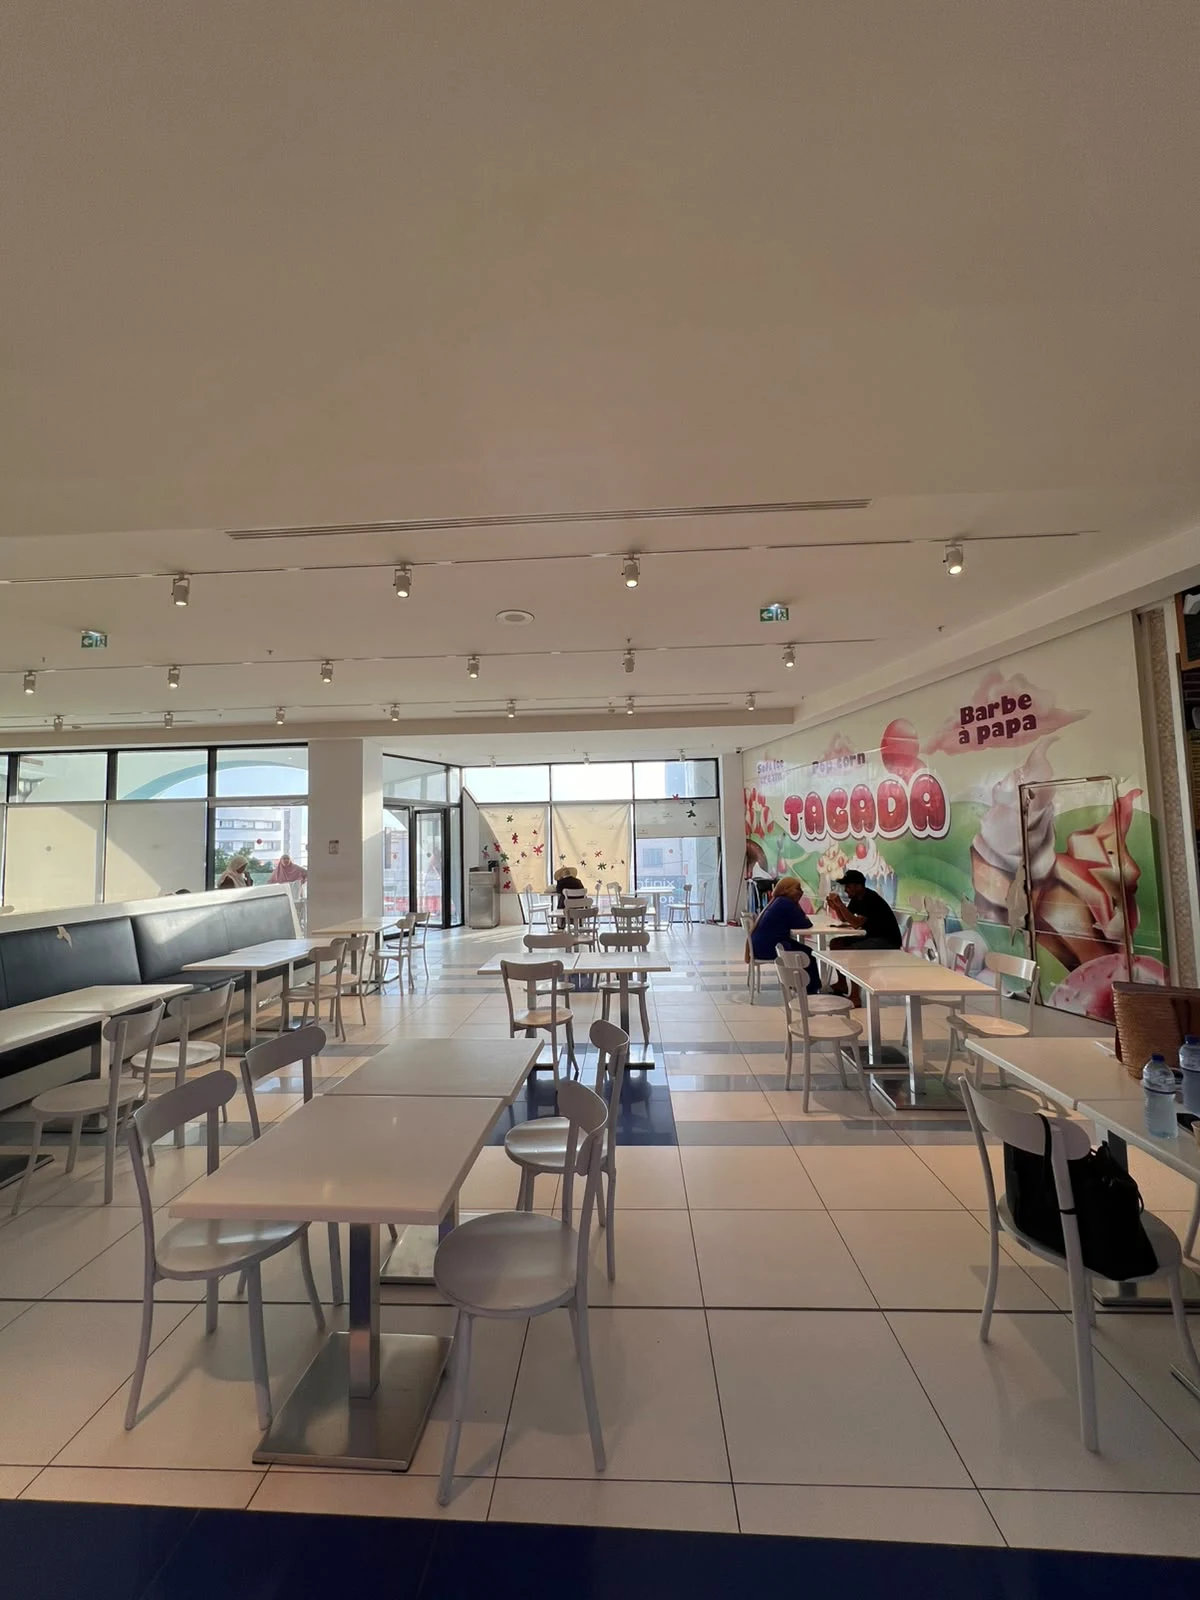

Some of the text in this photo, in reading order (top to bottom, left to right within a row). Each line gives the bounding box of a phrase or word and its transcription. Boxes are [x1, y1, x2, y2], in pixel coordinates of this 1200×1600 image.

[960, 694, 1032, 725] Barbe
[959, 714, 1037, 745] à papa
[783, 772, 949, 839] TAGADA
[638, 877, 675, 888] nfinix
